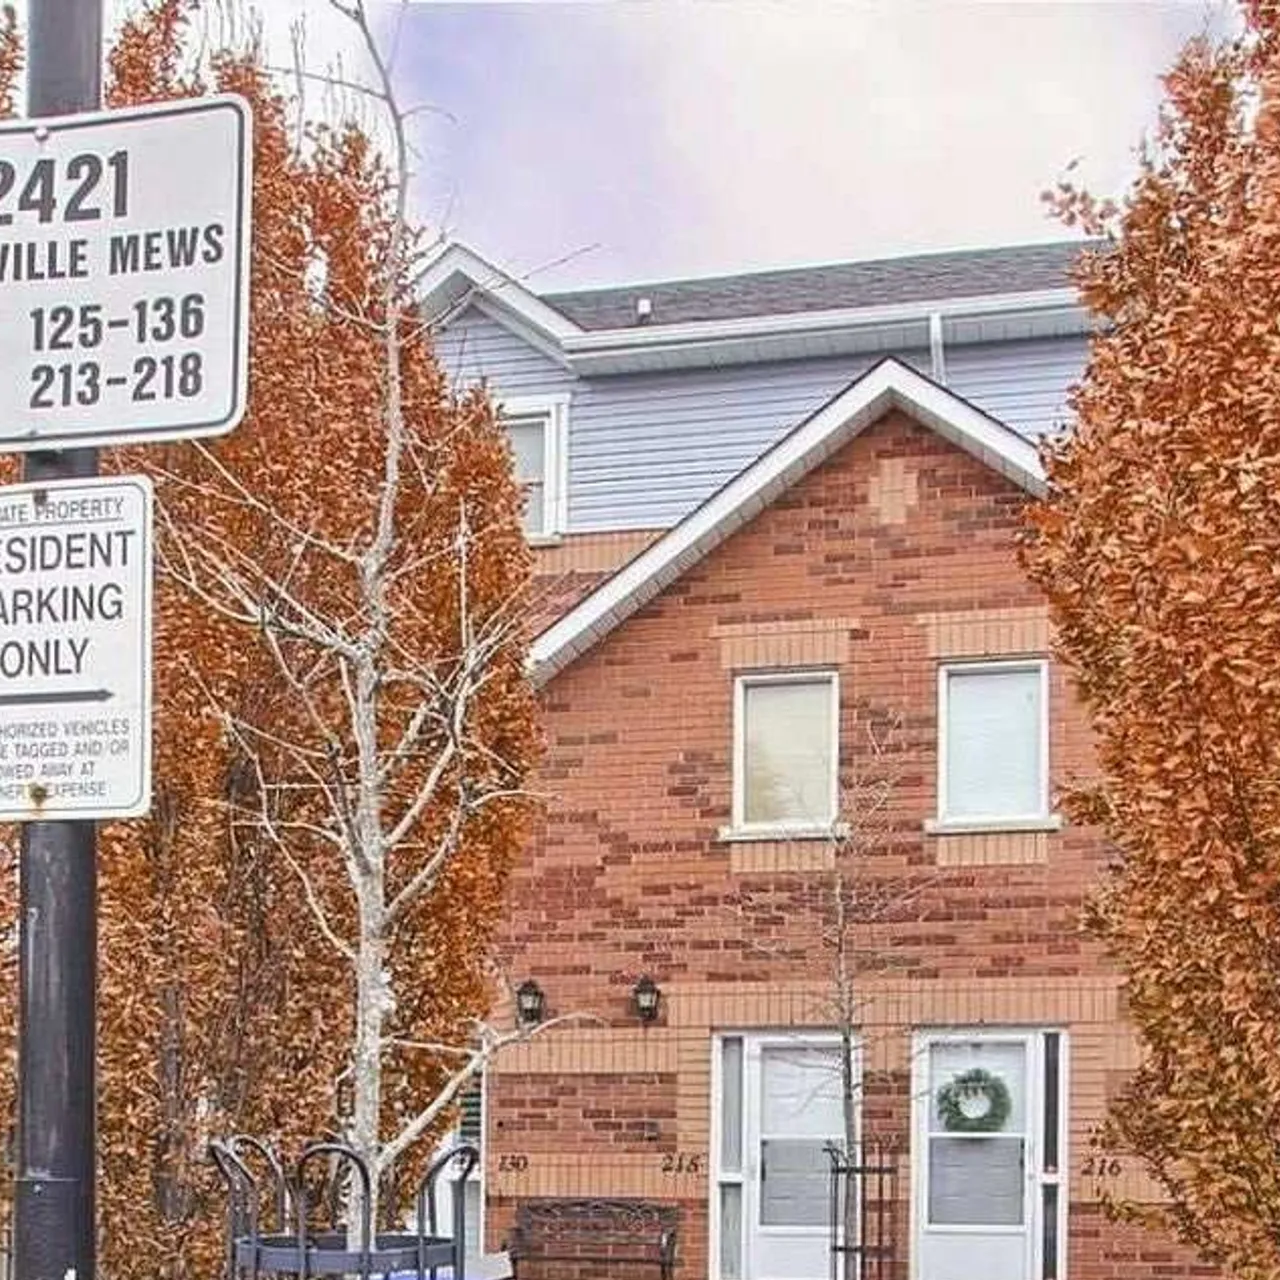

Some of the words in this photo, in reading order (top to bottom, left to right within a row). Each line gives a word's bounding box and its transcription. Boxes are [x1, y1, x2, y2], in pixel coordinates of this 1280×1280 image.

[109, 224, 225, 276] MEWS
[29, 294, 205, 351] 125-136
[29, 353, 204, 409] 213-218
[35, 496, 124, 520] PROPERTY
[0, 638, 90, 678] ONLY
[63, 719, 130, 736] VEHICLES
[14, 741, 69, 758] TAGGED
[80, 761, 95, 776] AT
[1081, 1158, 1122, 1177] 216
